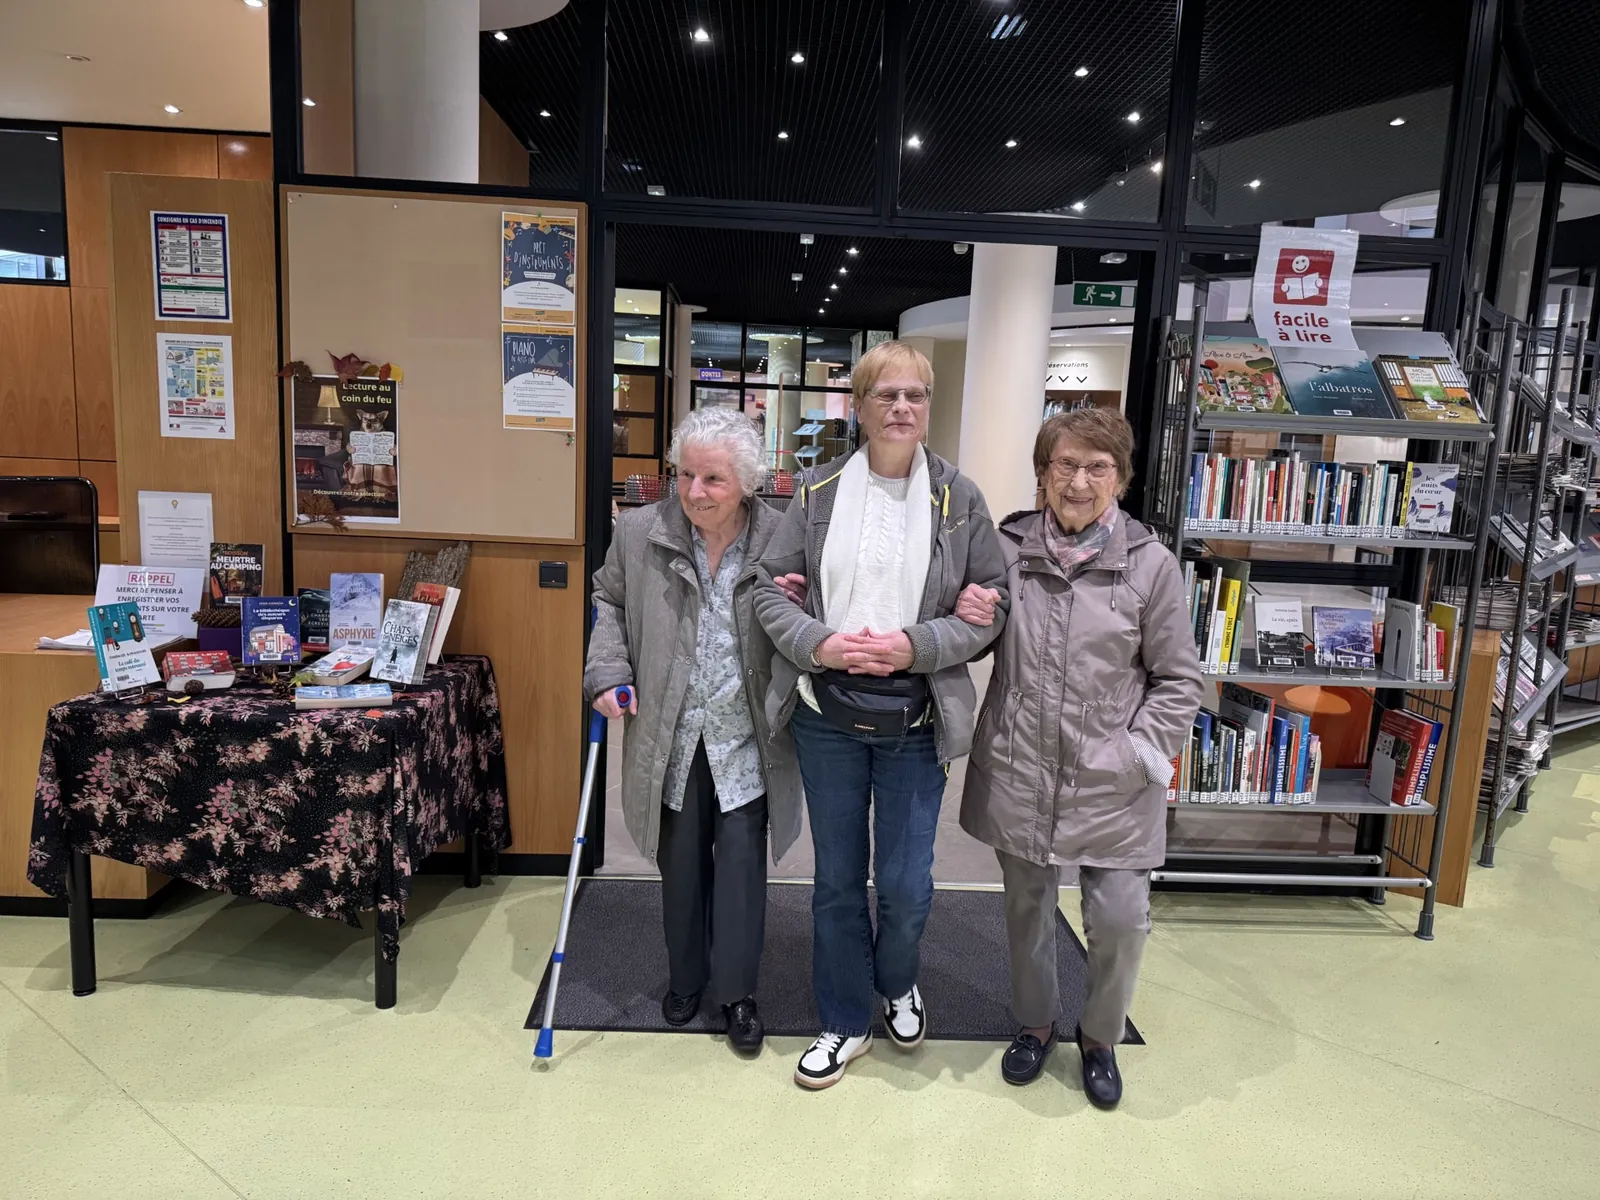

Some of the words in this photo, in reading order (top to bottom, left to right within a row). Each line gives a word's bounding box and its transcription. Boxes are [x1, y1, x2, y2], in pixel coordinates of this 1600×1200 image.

[1273, 310, 1329, 328] facile
[1278, 328, 1290, 341] à
[1295, 329, 1332, 343] lire
[512, 341, 536, 357] PIANO
[342, 383, 377, 392] Lecture
[379, 384, 391, 392] au
[1308, 381, 1373, 394] l'albatros
[341, 394, 361, 403] coin
[362, 396, 375, 404] du
[376, 395, 392, 404] feu
[210, 562, 222, 570] AU
[223, 563, 262, 571] CAMPING
[216, 556, 256, 564] MEURTRE
[130, 574, 172, 584] RAPPEL
[116, 586, 139, 594] MERCI
[150, 587, 177, 595] PENSER
[178, 585, 184, 594] À
[333, 628, 377, 640] ASPHYXIE
[383, 621, 411, 635] CHATS
[388, 634, 420, 648] NEIGES
[1276, 744, 1287, 792] SIMPLISSIME
[1408, 748, 1426, 795] SIMPLISSIME
[1416, 743, 1437, 794] SIMPLISSIME
